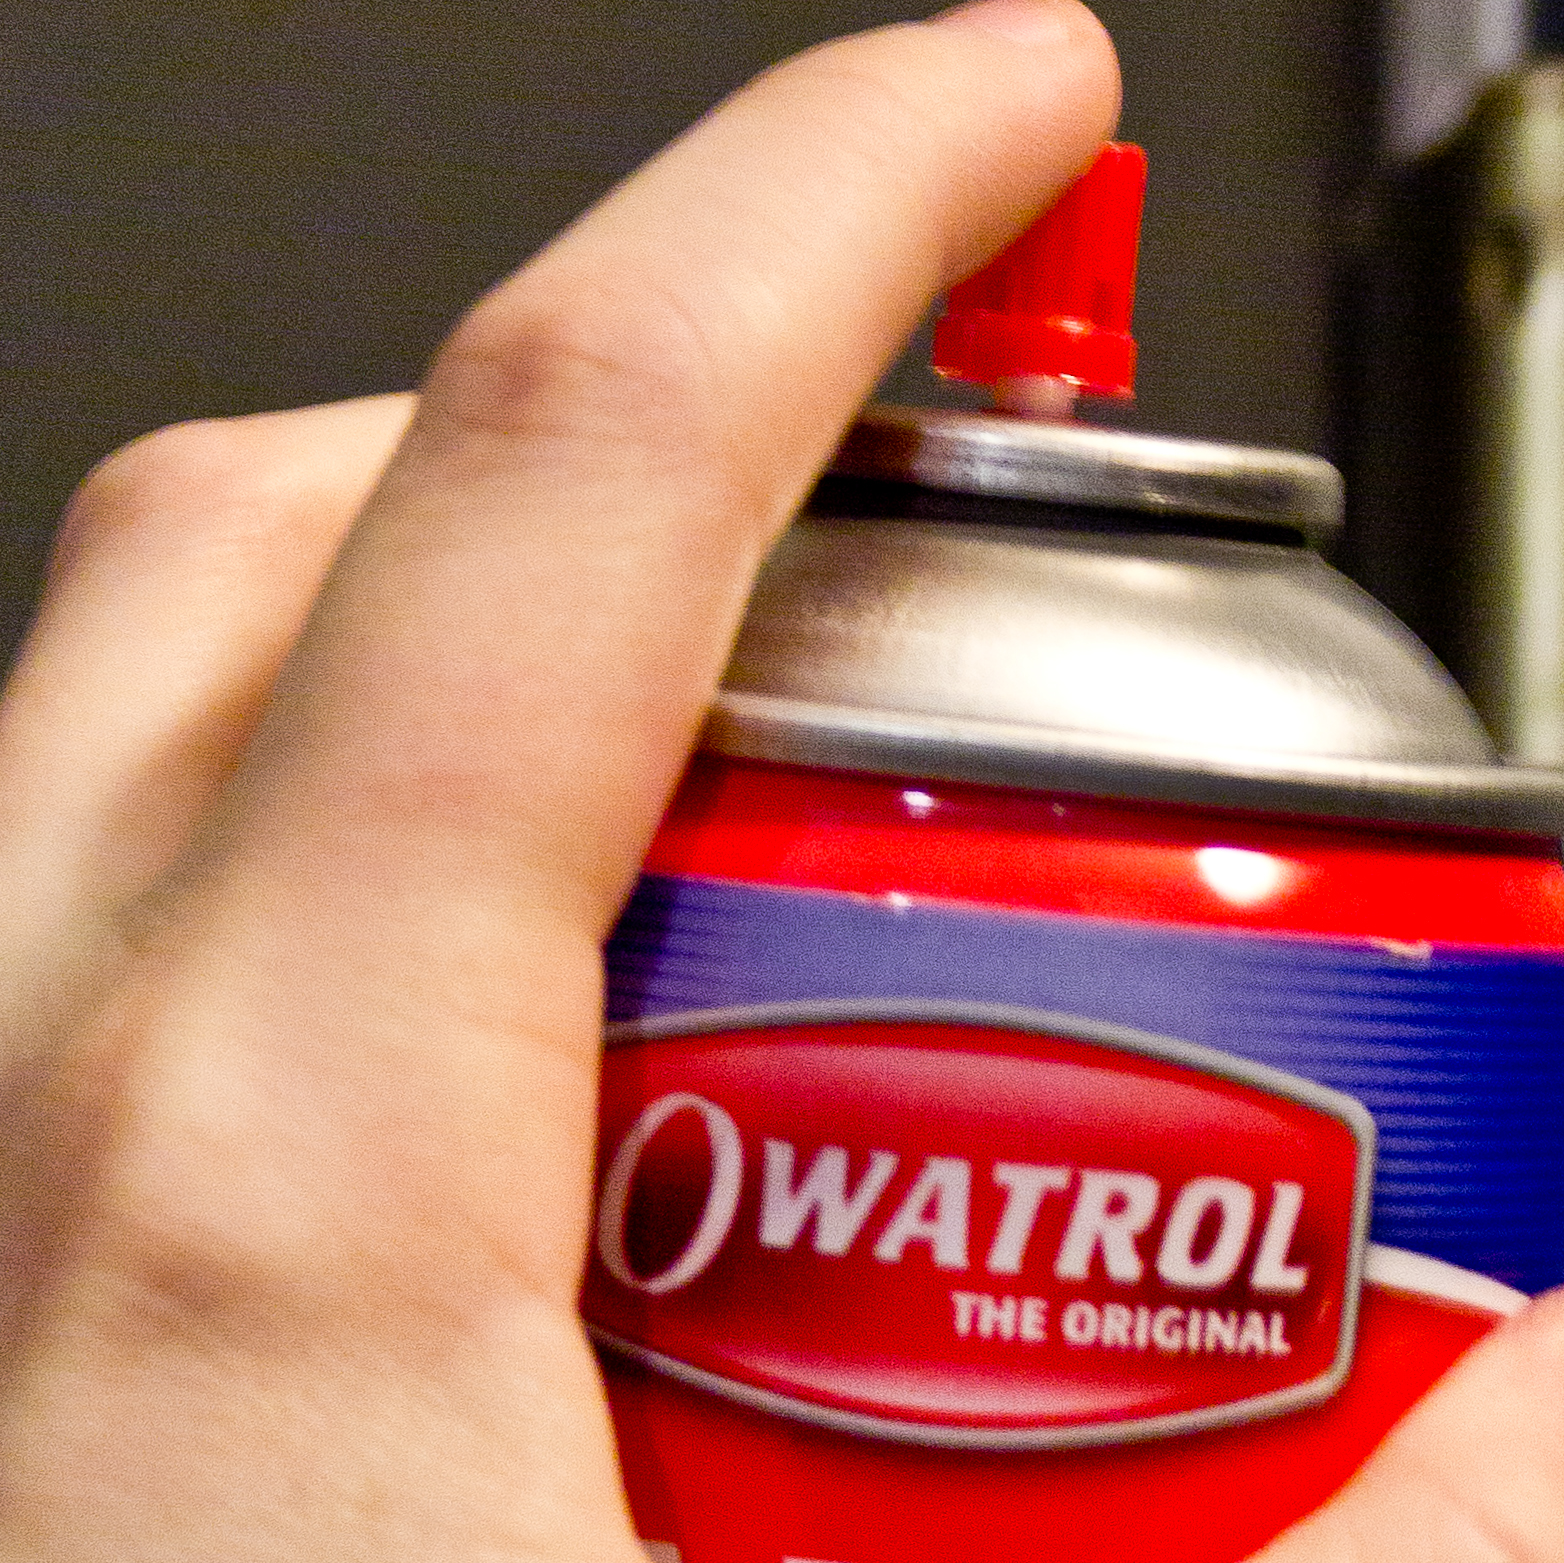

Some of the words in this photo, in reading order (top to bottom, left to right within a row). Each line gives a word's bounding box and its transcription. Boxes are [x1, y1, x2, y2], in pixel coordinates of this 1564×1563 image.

[599, 1091, 1309, 1294] OWATROL
[951, 1290, 1047, 1341] THE
[1060, 1298, 1291, 1356] ORIGINAL
